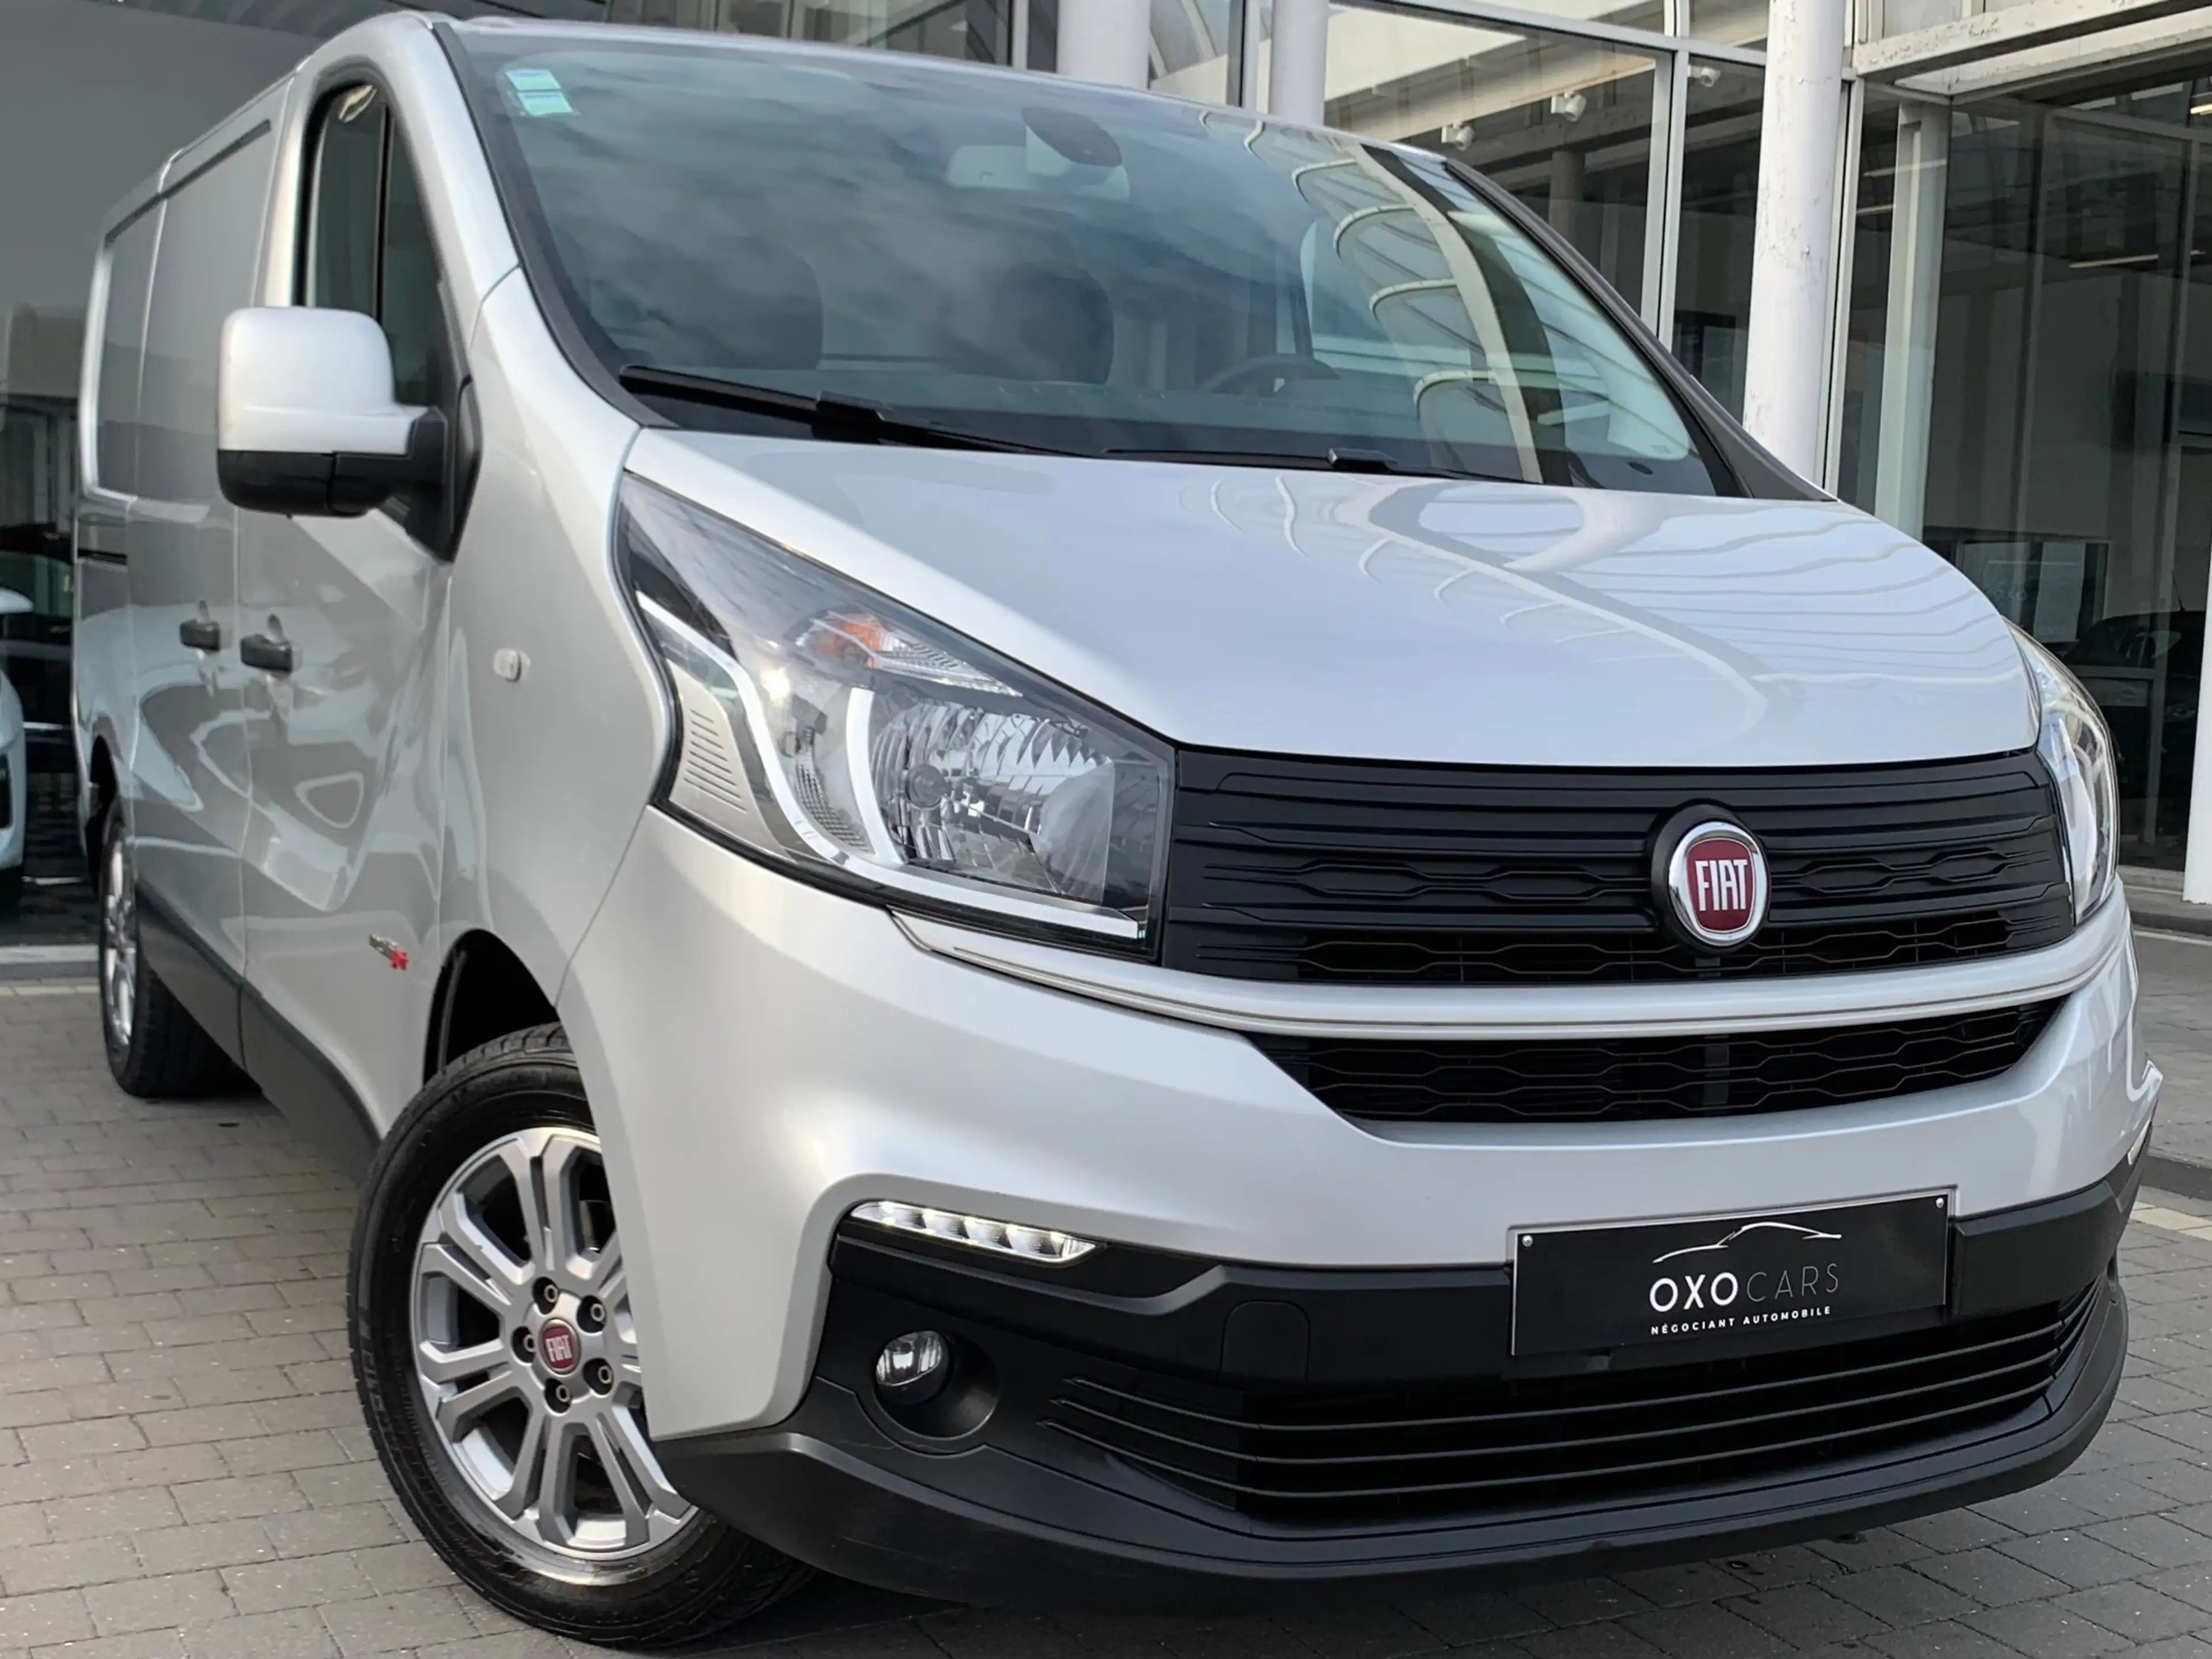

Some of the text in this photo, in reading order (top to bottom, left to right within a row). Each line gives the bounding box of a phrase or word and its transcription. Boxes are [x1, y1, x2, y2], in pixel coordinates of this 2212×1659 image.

[1695, 859, 1748, 911] FIAT
[1649, 1263, 1839, 1312] OXO CARS
[1650, 1306, 1831, 1335] NÉGOCIANT AUTOMOBILE
[544, 1334, 573, 1362] FIAT
